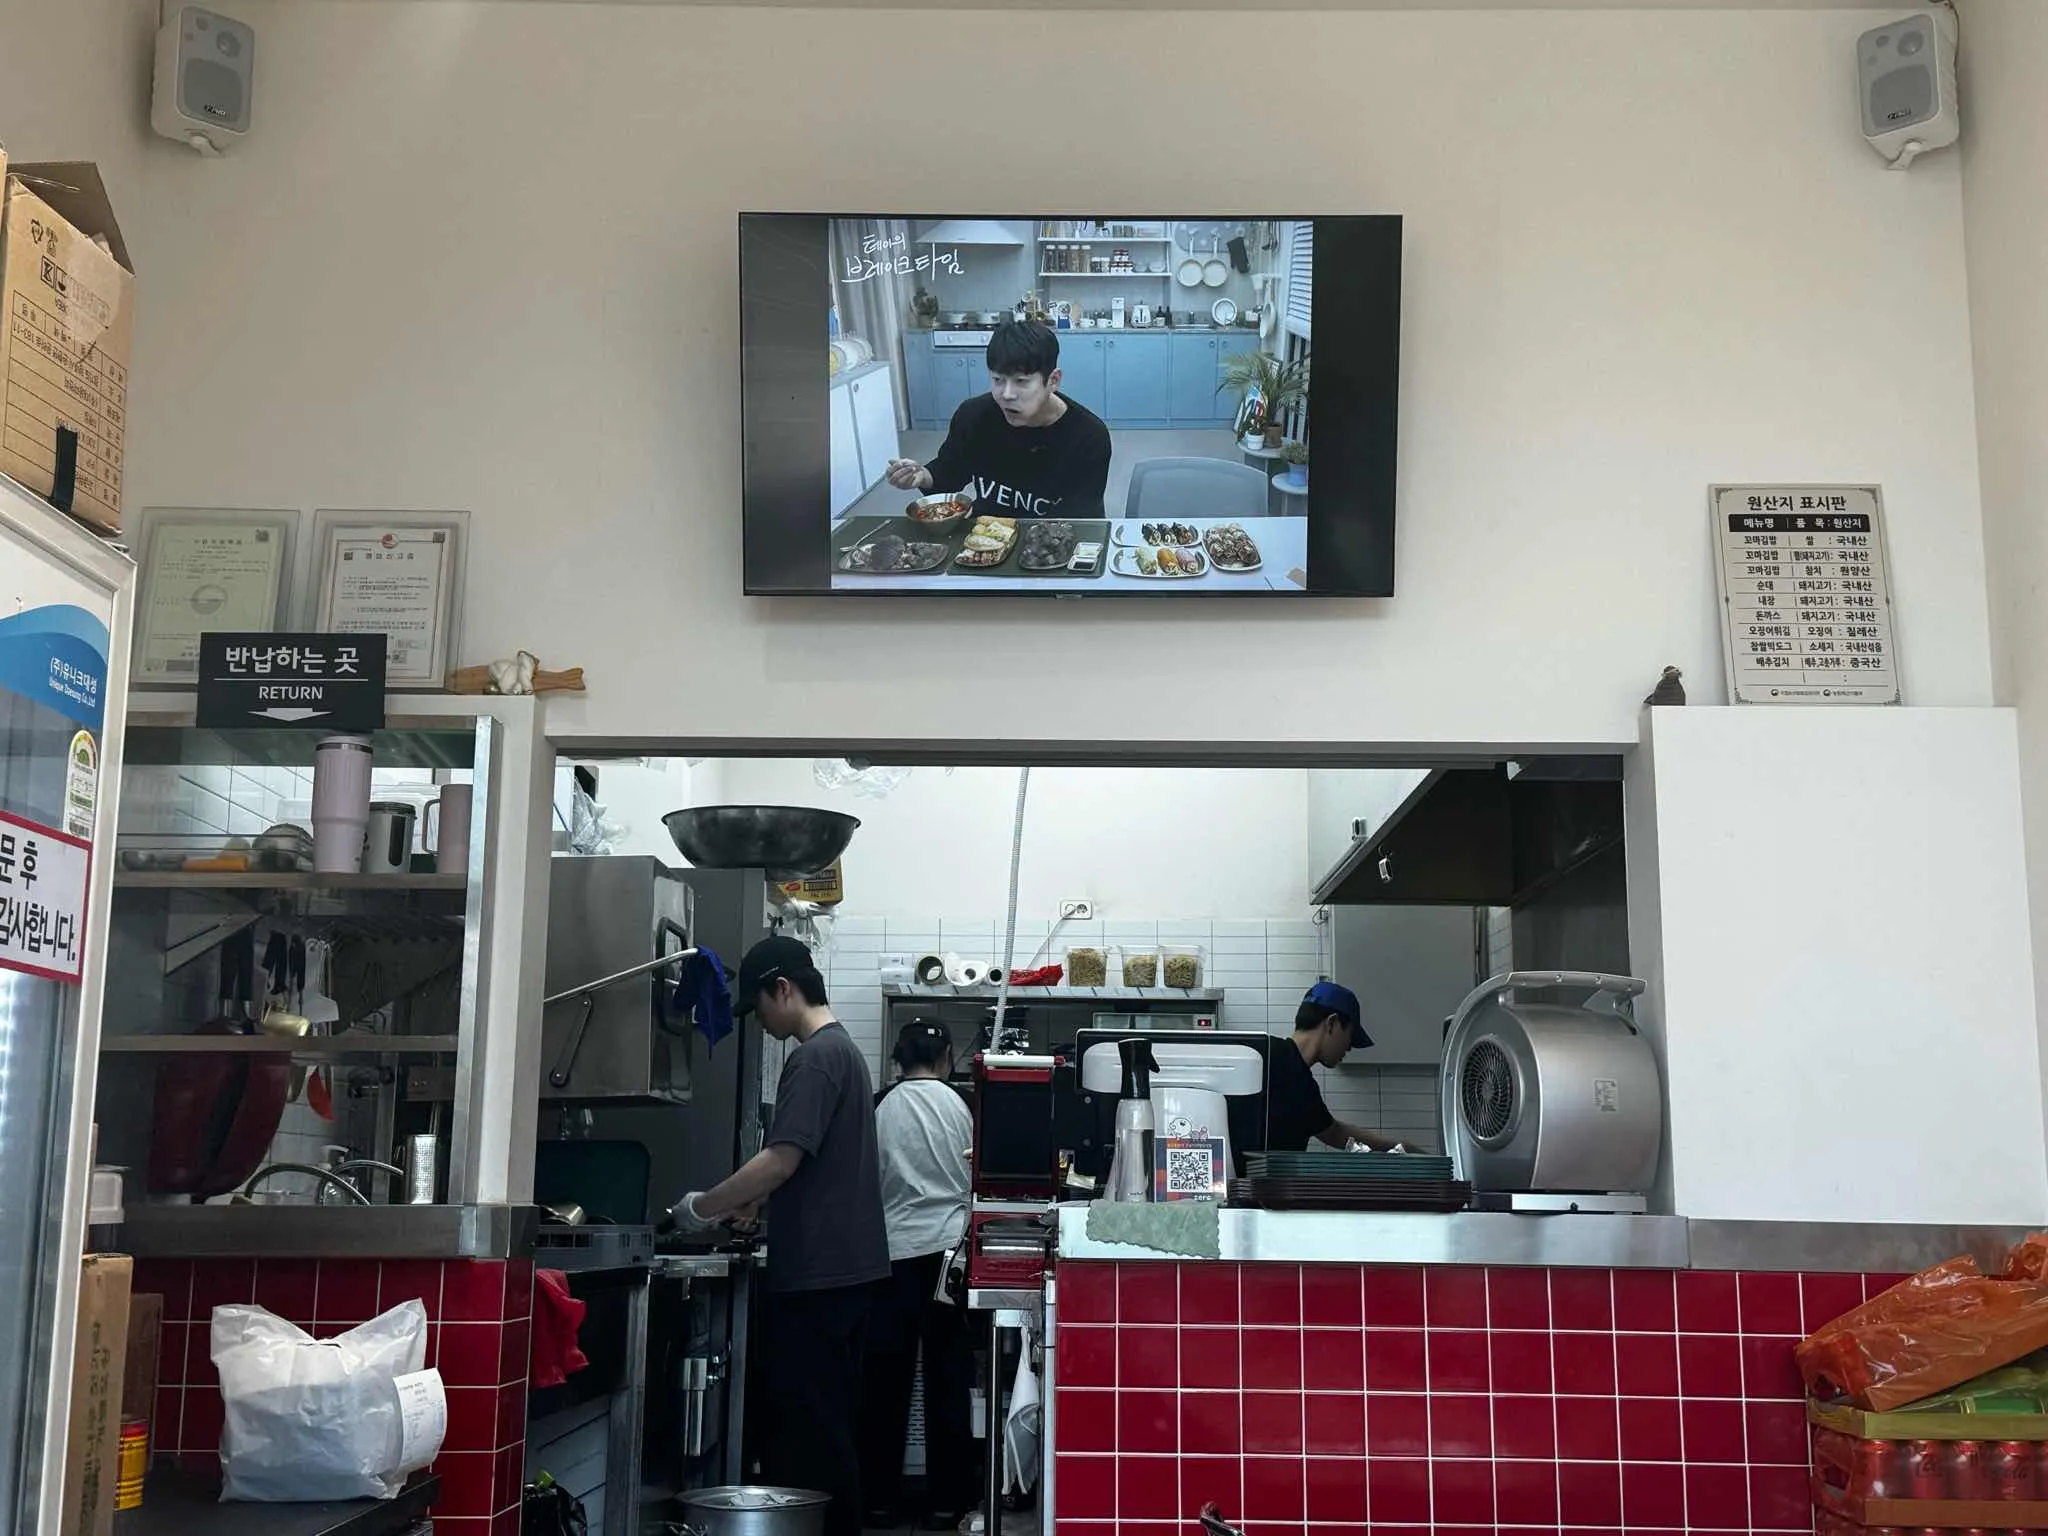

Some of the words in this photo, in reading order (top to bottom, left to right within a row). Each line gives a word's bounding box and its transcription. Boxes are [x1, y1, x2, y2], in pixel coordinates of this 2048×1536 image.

[1747, 496, 1793, 511] 원산지
[1800, 496, 1846, 511] 표시판
[1744, 518, 1774, 529] 메뉴명
[1834, 518, 1861, 529] 원산지
[1744, 536, 1777, 545] 꼬마김밥
[1836, 536, 1867, 546] 국내산
[1746, 551, 1779, 560] 꼬마김밥
[1838, 551, 1869, 561] 국내산
[1747, 566, 1780, 576] 꼬마김밥
[1805, 566, 1822, 576] 참치
[1757, 581, 1774, 590] 순대
[1799, 581, 1832, 591] 돼지고기
[1841, 581, 1872, 591] 국내산
[1758, 596, 1775, 606] 내장
[1800, 596, 1834, 606] 돼지고기
[1843, 596, 1873, 606] 국내산
[1756, 612, 1781, 622] 돈까스
[1801, 611, 1835, 621] 돼지고기
[1845, 612, 1875, 622] 국내산
[1749, 627, 1790, 637] 오징어튀김
[1808, 627, 1833, 637] 오징어
[1847, 627, 1877, 637] 칠레산
[1809, 642, 1834, 652] 소세지
[226, 646, 327, 673] 반납하는
[334, 647, 360, 673] 곳
[1756, 657, 1790, 667] 배추김치
[1850, 658, 1881, 668] 중국산
[259, 686, 323, 700] RETURN
[20, 840, 38, 890] 후
